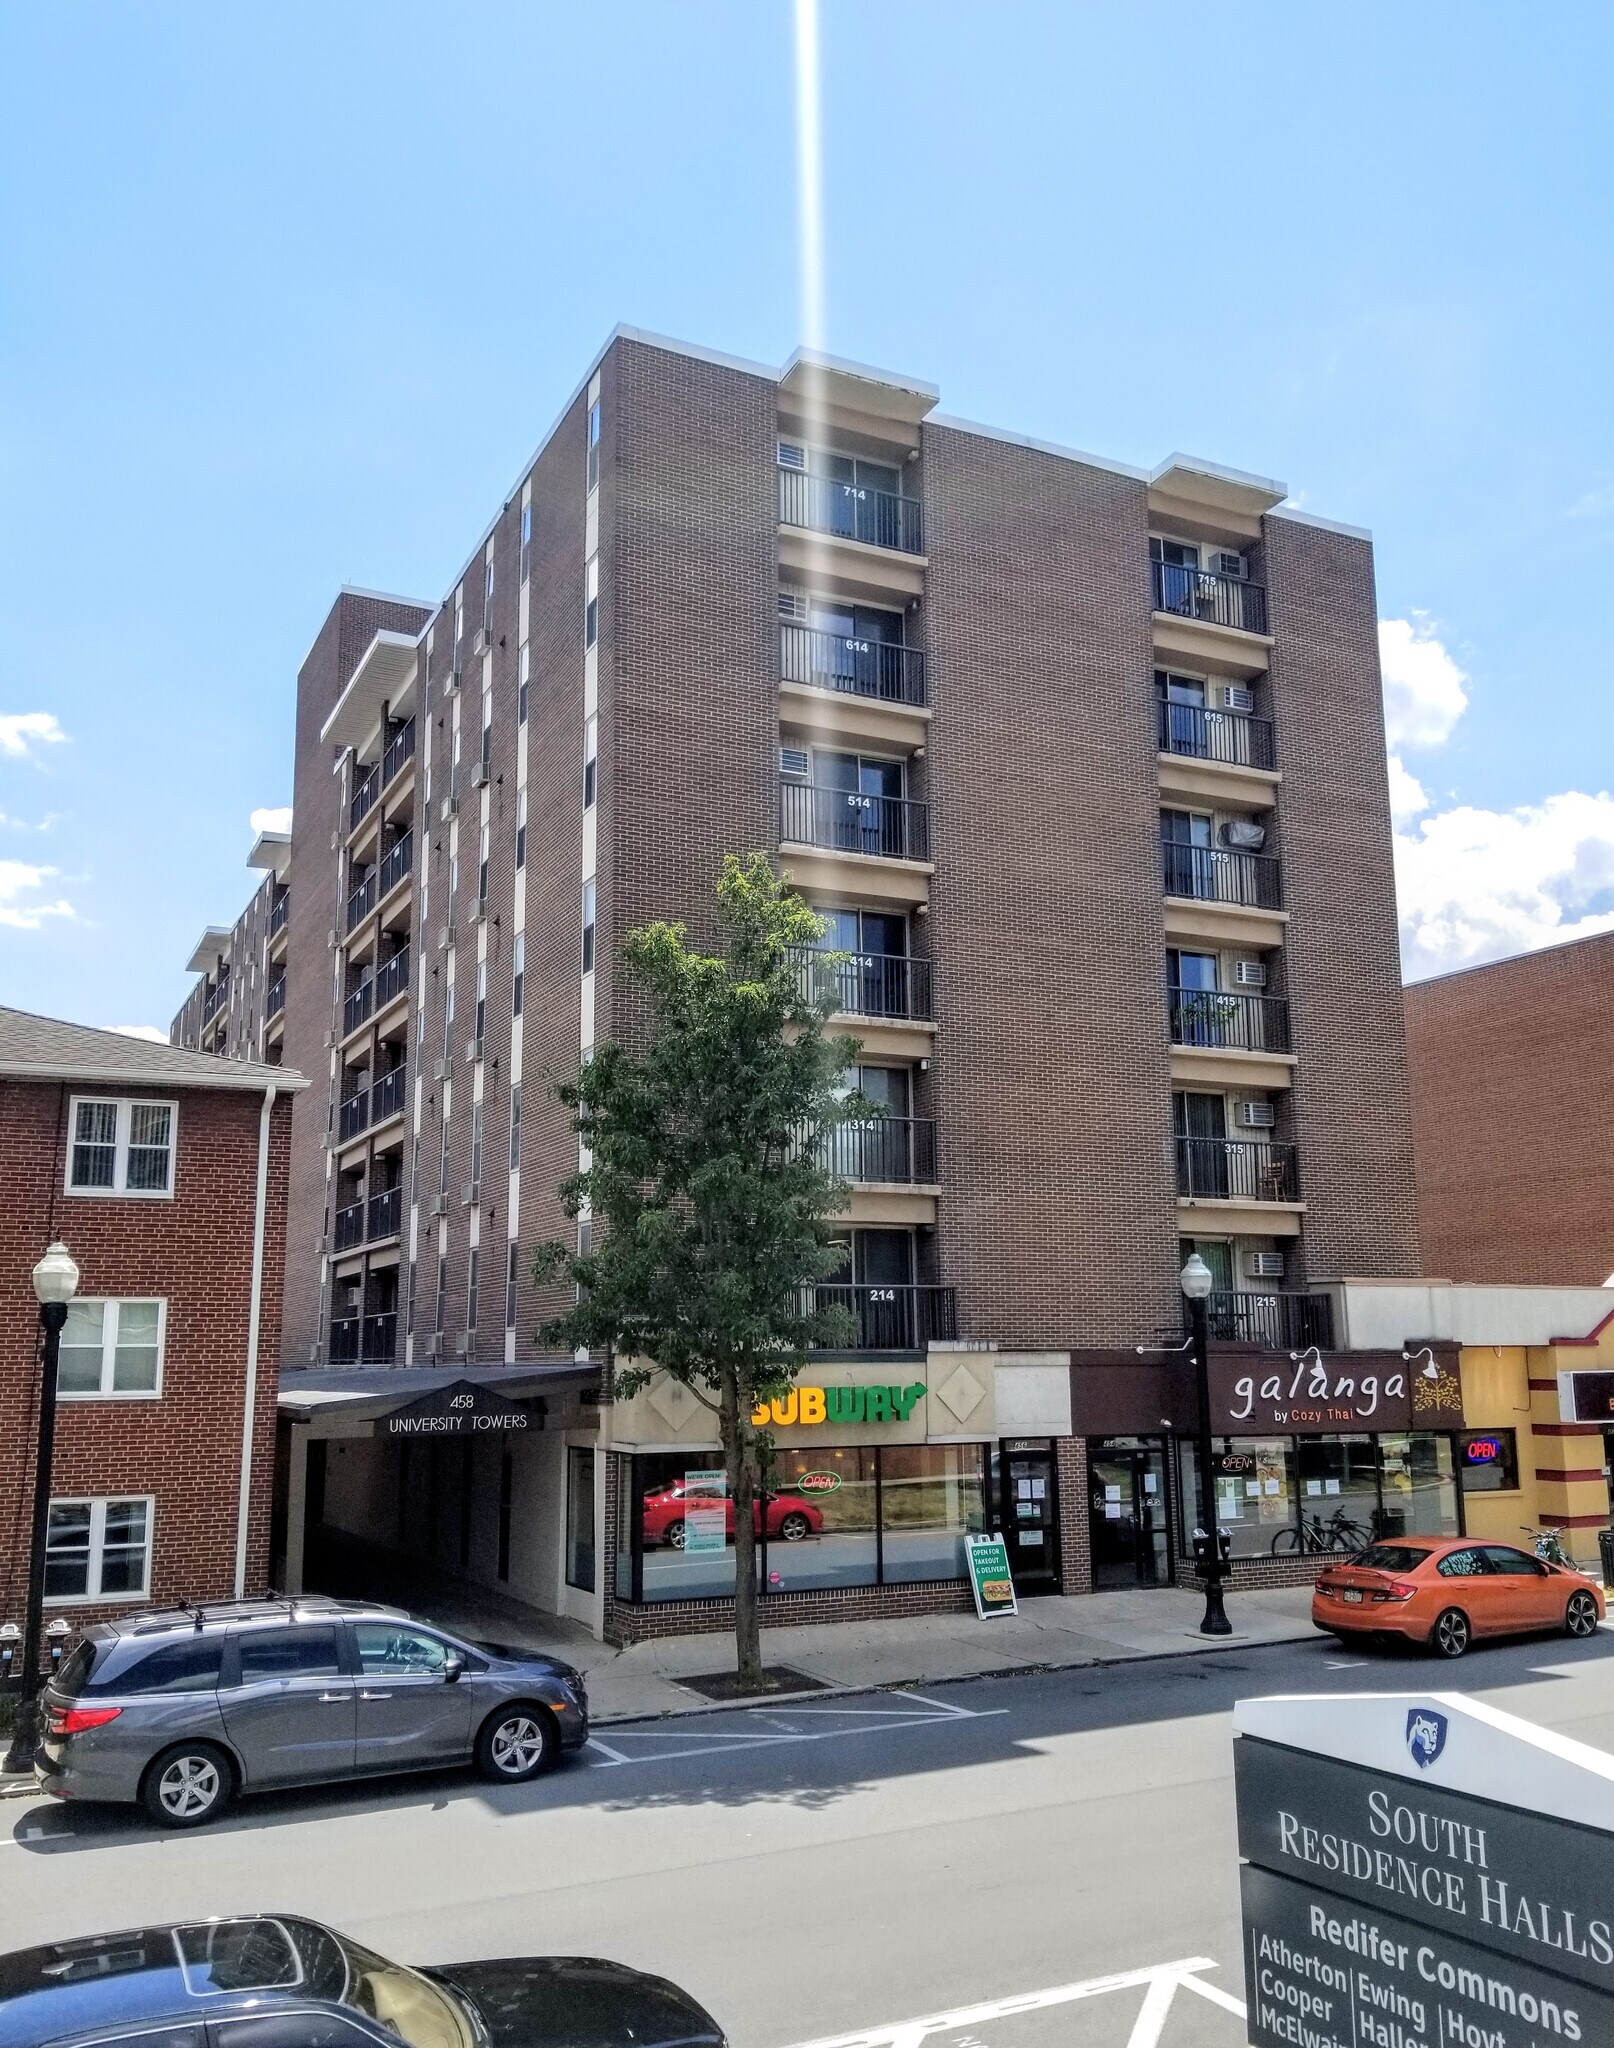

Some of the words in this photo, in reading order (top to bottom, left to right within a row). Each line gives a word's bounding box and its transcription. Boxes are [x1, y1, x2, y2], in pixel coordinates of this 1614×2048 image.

[843, 486, 866, 500] 714
[1198, 574, 1216, 586] 715
[845, 640, 868, 653] 614
[1204, 712, 1223, 723] 615
[848, 796, 870, 808] 514
[1210, 852, 1229, 863] 515
[849, 956, 872, 968] 414
[1217, 996, 1236, 1006] 415
[851, 1119, 874, 1131] 314
[1225, 1143, 1244, 1154] 315
[870, 1289, 894, 1302] 214
[1256, 1296, 1276, 1308] 215
[1229, 1363, 1405, 1419] galanga
[450, 1395, 474, 1408] 458
[1274, 1410, 1288, 1423] by
[1291, 1409, 1321, 1422] Cozy
[1327, 1408, 1353, 1420] Thai
[389, 1416, 463, 1433] UNIVERSITY
[472, 1414, 527, 1430] TOWERS
[1468, 1443, 1496, 1458] OPEN
[1222, 1457, 1250, 1468] OPEN
[803, 1476, 835, 1489] OPEN
[981, 1565, 1006, 1573] DELIVERY
[1368, 1791, 1488, 1869] SOUTH
[1278, 1811, 1467, 1915] RESIDENCE
[1477, 1874, 1614, 1965] HALLS
[1259, 1933, 1347, 1993] Atherton
[1310, 1904, 1409, 1971] Redifer
[1417, 1947, 1582, 2041] Commons
[1261, 1969, 1333, 2021] Cooper
[1358, 1973, 1426, 2033] Ewing
[1262, 2003, 1347, 2048] McElwai
[1448, 2009, 1506, 2048] Hoyt
